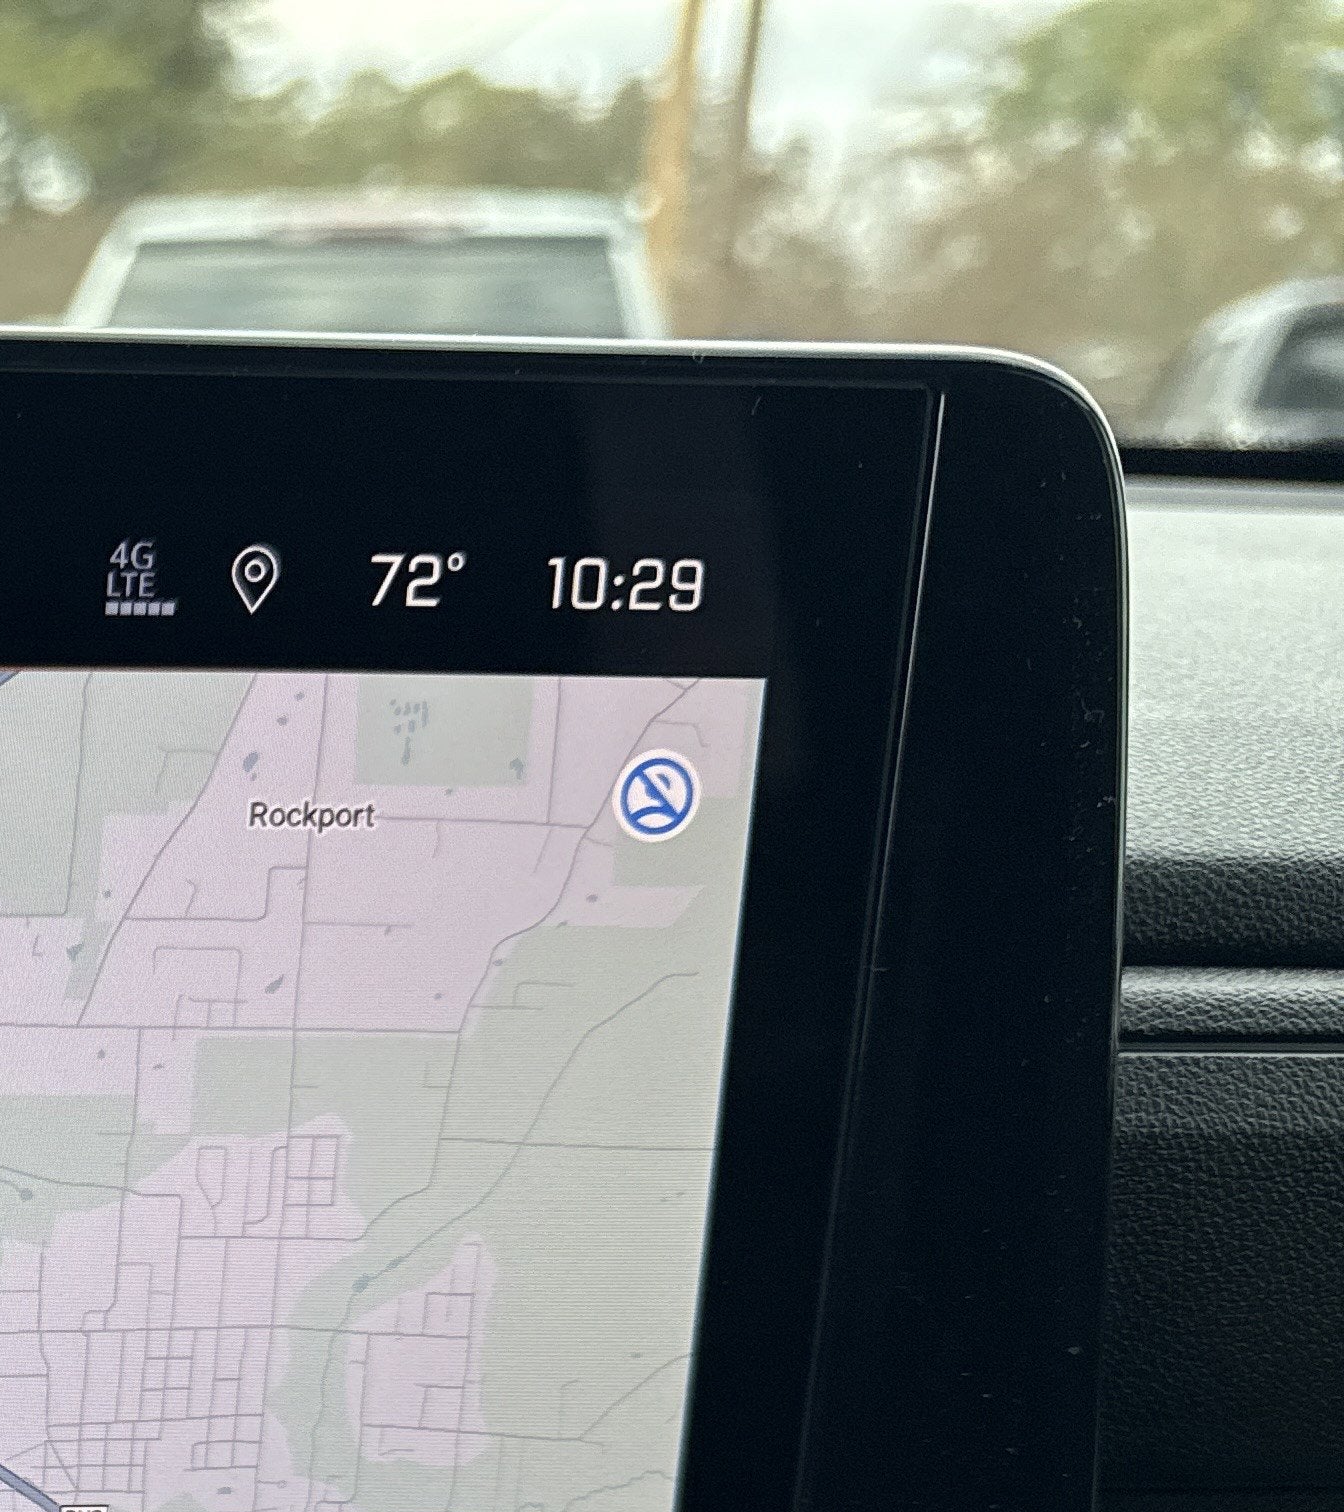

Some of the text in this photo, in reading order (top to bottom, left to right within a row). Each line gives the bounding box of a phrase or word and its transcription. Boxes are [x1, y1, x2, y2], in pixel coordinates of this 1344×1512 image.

[109, 540, 154, 569] 4G
[106, 571, 155, 597] LTE
[370, 552, 466, 607] 72°
[547, 556, 706, 612] 10:29
[249, 801, 376, 834] Rockport
